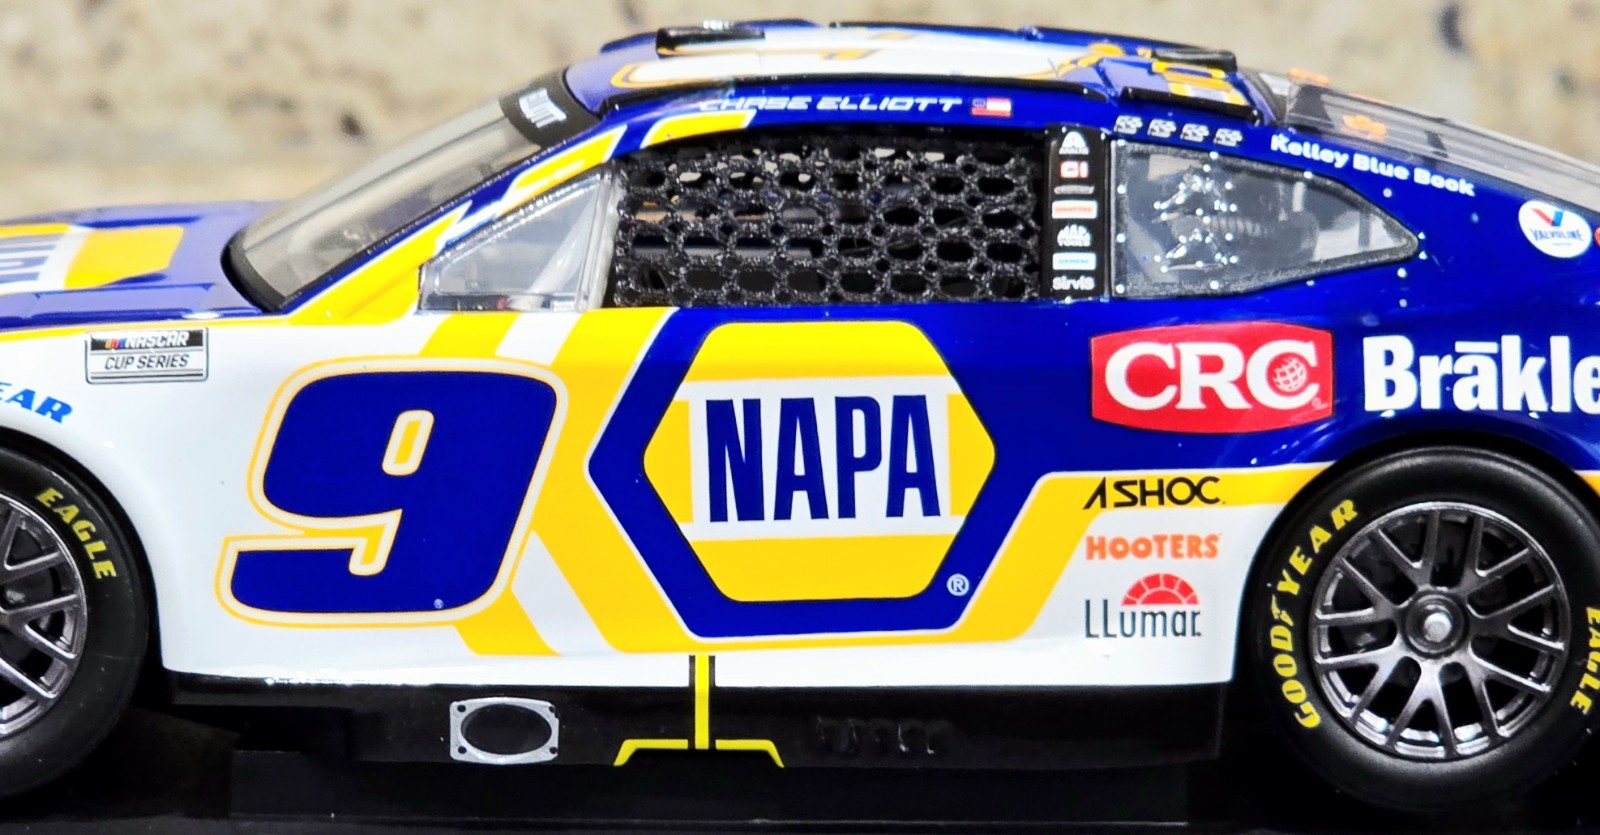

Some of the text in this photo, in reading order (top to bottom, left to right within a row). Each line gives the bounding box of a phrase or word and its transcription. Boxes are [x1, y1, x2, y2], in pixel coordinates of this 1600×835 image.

[816, 96, 963, 112] ELLIOTT
[1270, 133, 1477, 198] Kelley Blue Book
[1528, 227, 1585, 242] VALVOLINE
[104, 353, 190, 370] CUP SERIES
[124, 330, 190, 349] NASCAR
[1104, 339, 1321, 411] CRC
[705, 393, 942, 523] NAPA
[216, 354, 569, 629] 9
[1083, 475, 1221, 510] ASHOC
[35, 487, 117, 580] EAGLE
[1085, 533, 1220, 561] HOOTERS
[1270, 499, 1358, 729] GOODYEAR
